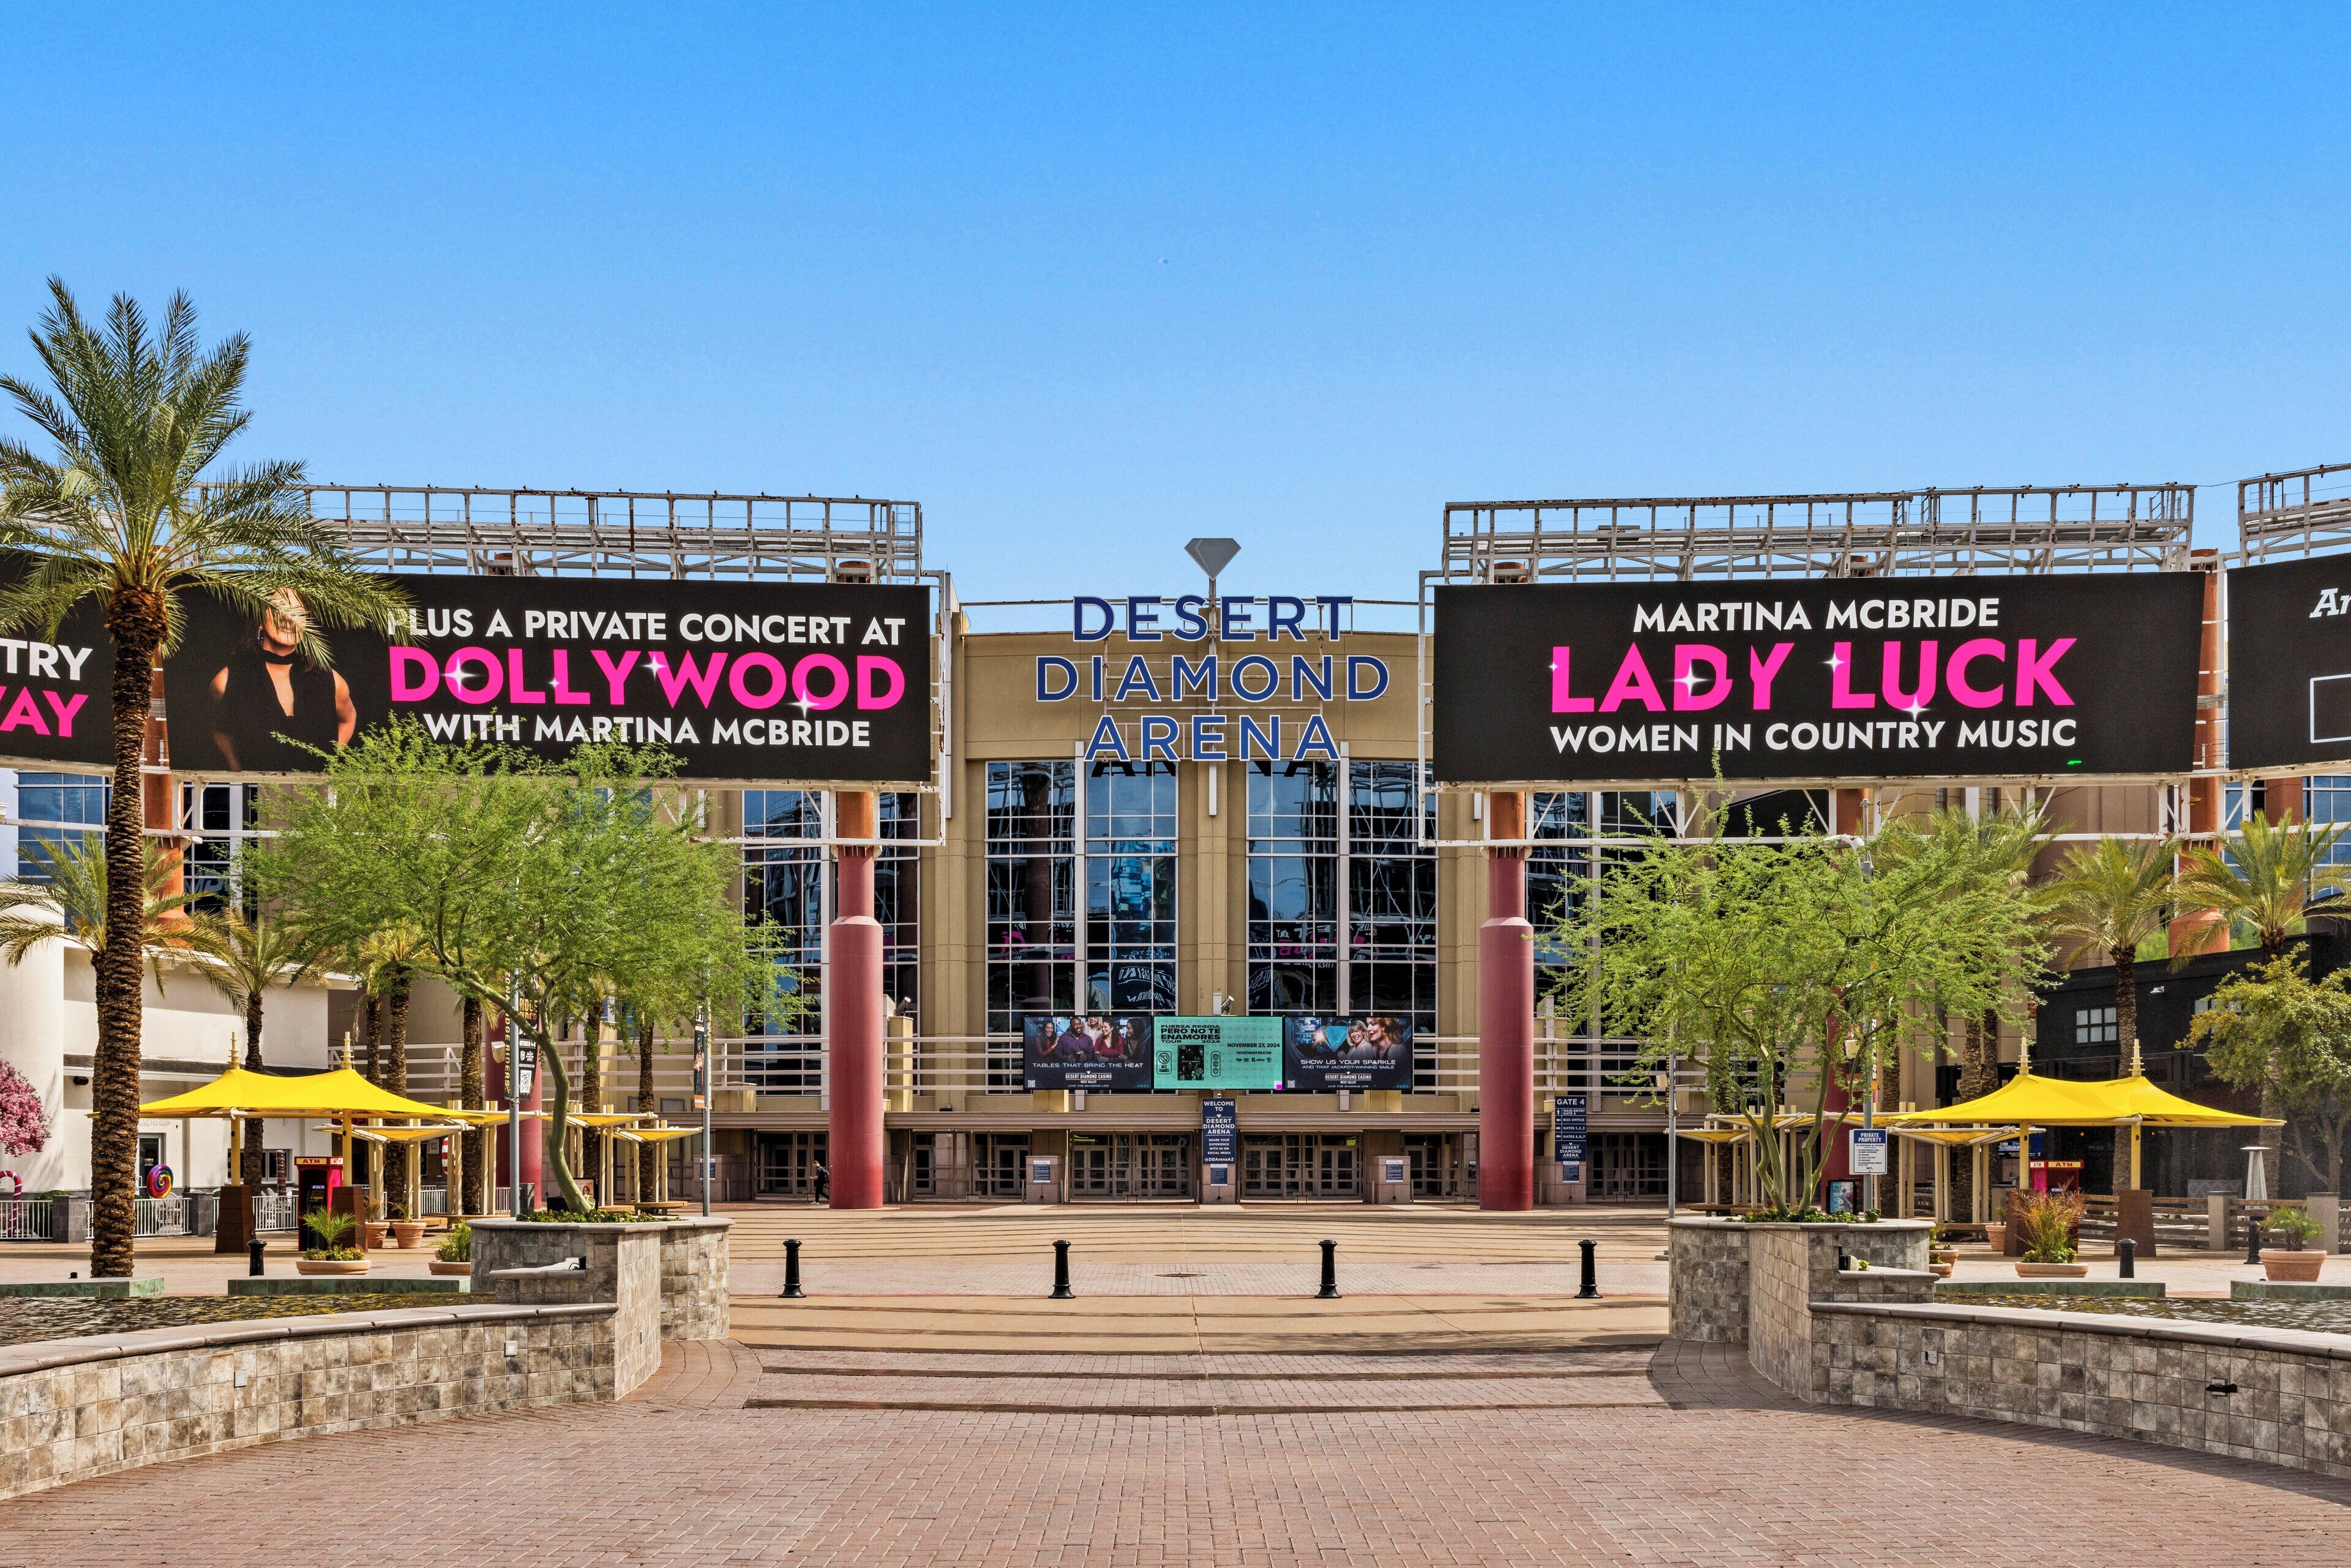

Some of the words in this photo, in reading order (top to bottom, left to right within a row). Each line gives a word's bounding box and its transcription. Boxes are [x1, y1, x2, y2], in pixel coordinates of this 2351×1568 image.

[486, 609, 513, 637] A
[525, 610, 666, 640] PRIVATE
[680, 613, 851, 644] CONCERT
[861, 617, 906, 645] AT
[1073, 595, 1354, 642] DESERT
[1633, 600, 1812, 632] MARTINA
[1826, 598, 1999, 629] MCBRIDE
[0, 637, 93, 681] TRY
[389, 646, 906, 710] DOLLYWOOD
[1036, 655, 1390, 703] DIAMOND
[1551, 642, 1795, 713] LADY
[1832, 638, 2078, 710] LUCK
[0, 685, 89, 738] AY
[423, 713, 520, 741] WITH
[534, 714, 700, 745] MARTINA
[711, 718, 870, 747] MCBRIDE
[1083, 714, 1341, 762] ARENA
[1550, 724, 1698, 754] WOMEN
[1714, 723, 1751, 752] IN
[1765, 721, 1946, 751] COUNTRY
[1957, 719, 2076, 748] MUSIC
